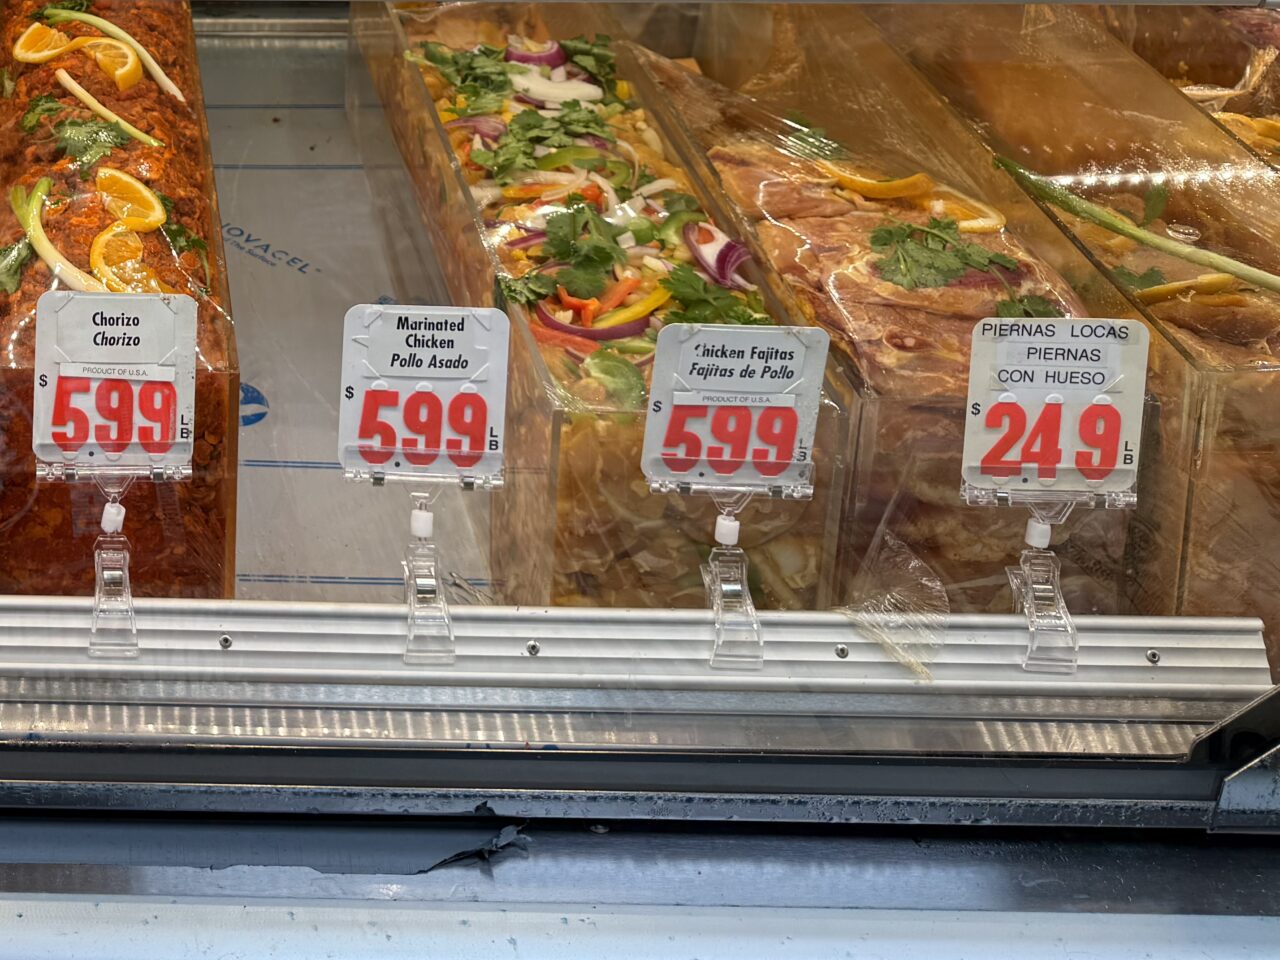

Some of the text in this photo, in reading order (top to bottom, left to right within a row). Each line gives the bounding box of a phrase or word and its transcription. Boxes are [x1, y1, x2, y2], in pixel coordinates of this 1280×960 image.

[92, 311, 140, 327] Chorizo
[396, 316, 465, 332] Marinated
[93, 331, 140, 346] Chorizo
[981, 323, 1129, 339] PIERNAS LOCAS
[405, 334, 454, 349] Chicken
[390, 353, 469, 369] Pollo Asado
[750, 346, 795, 364] Fajitas
[1026, 347, 1101, 362] PIERNAS
[82, 366, 116, 375] PRODUCT
[688, 362, 735, 380] Fajitas
[739, 364, 756, 378] de
[998, 369, 1105, 385] CON HUESO
[702, 395, 738, 403] PRODUCT
